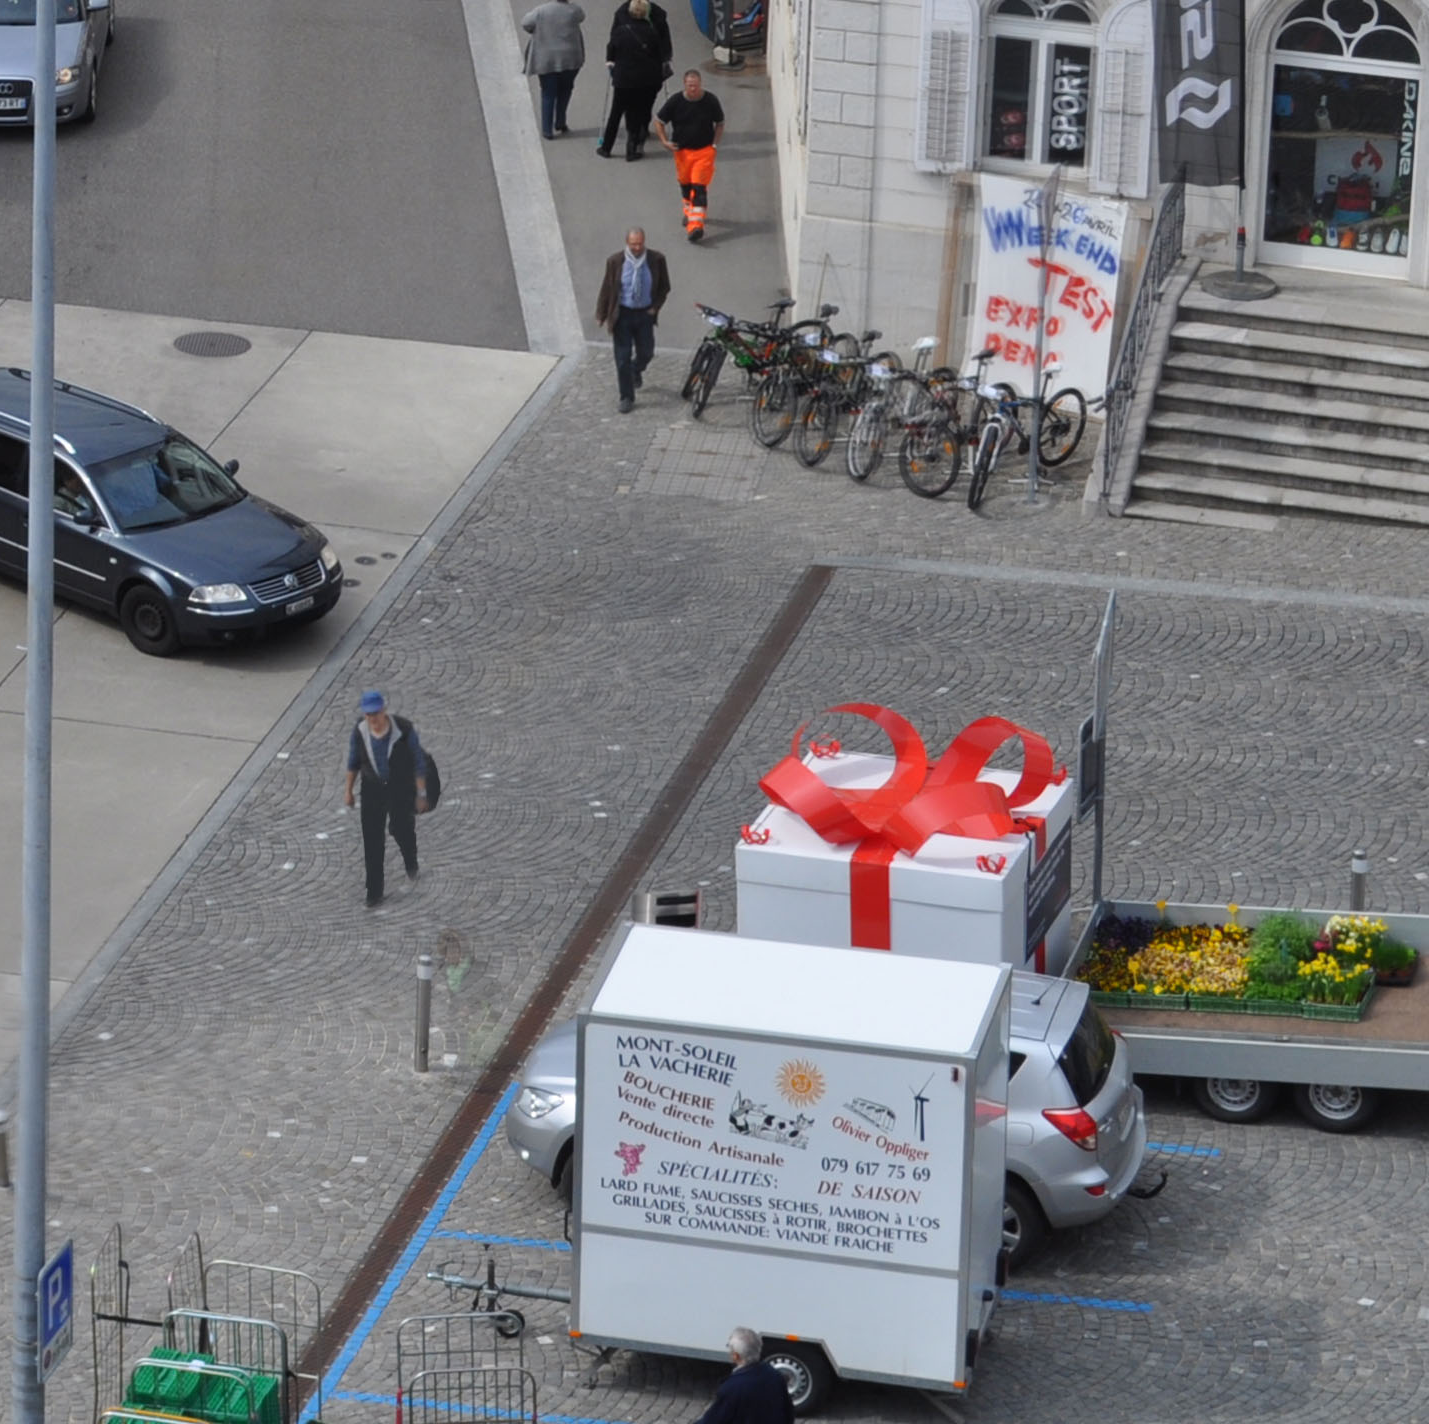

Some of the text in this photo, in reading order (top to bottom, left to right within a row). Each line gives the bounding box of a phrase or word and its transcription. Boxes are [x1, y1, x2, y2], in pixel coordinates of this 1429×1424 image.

[1050, 57, 1087, 151] SPORT
[1398, 80, 1417, 177] DAKINE
[1027, 257, 1113, 333] TEST
[616, 1034, 738, 1071] MONT-SOLEIL
[618, 1053, 734, 1088] LA VACHERIE
[617, 1085, 715, 1129] Vente directe
[623, 1070, 716, 1111] BOUCHERIE
[618, 1111, 786, 1168] Production Artisanale
[831, 1116, 930, 1162] Olivier Oppliger
[657, 1160, 779, 1190] SPÉCIALITÉS:
[821, 1156, 931, 1182] 079 617 75 69
[600, 1177, 941, 1230] LARD FUME, SAUCISSES SECHES, JAMBON à L'OS
[817, 1180, 922, 1205] DE SAISON
[612, 1193, 928, 1244] GRILLADES, SAUCISSES à ROTIR, BROCHETTES
[644, 1211, 894, 1254] SUR COMMANDE: VIANDE FRAICHE
[48, 1266, 62, 1331] P
